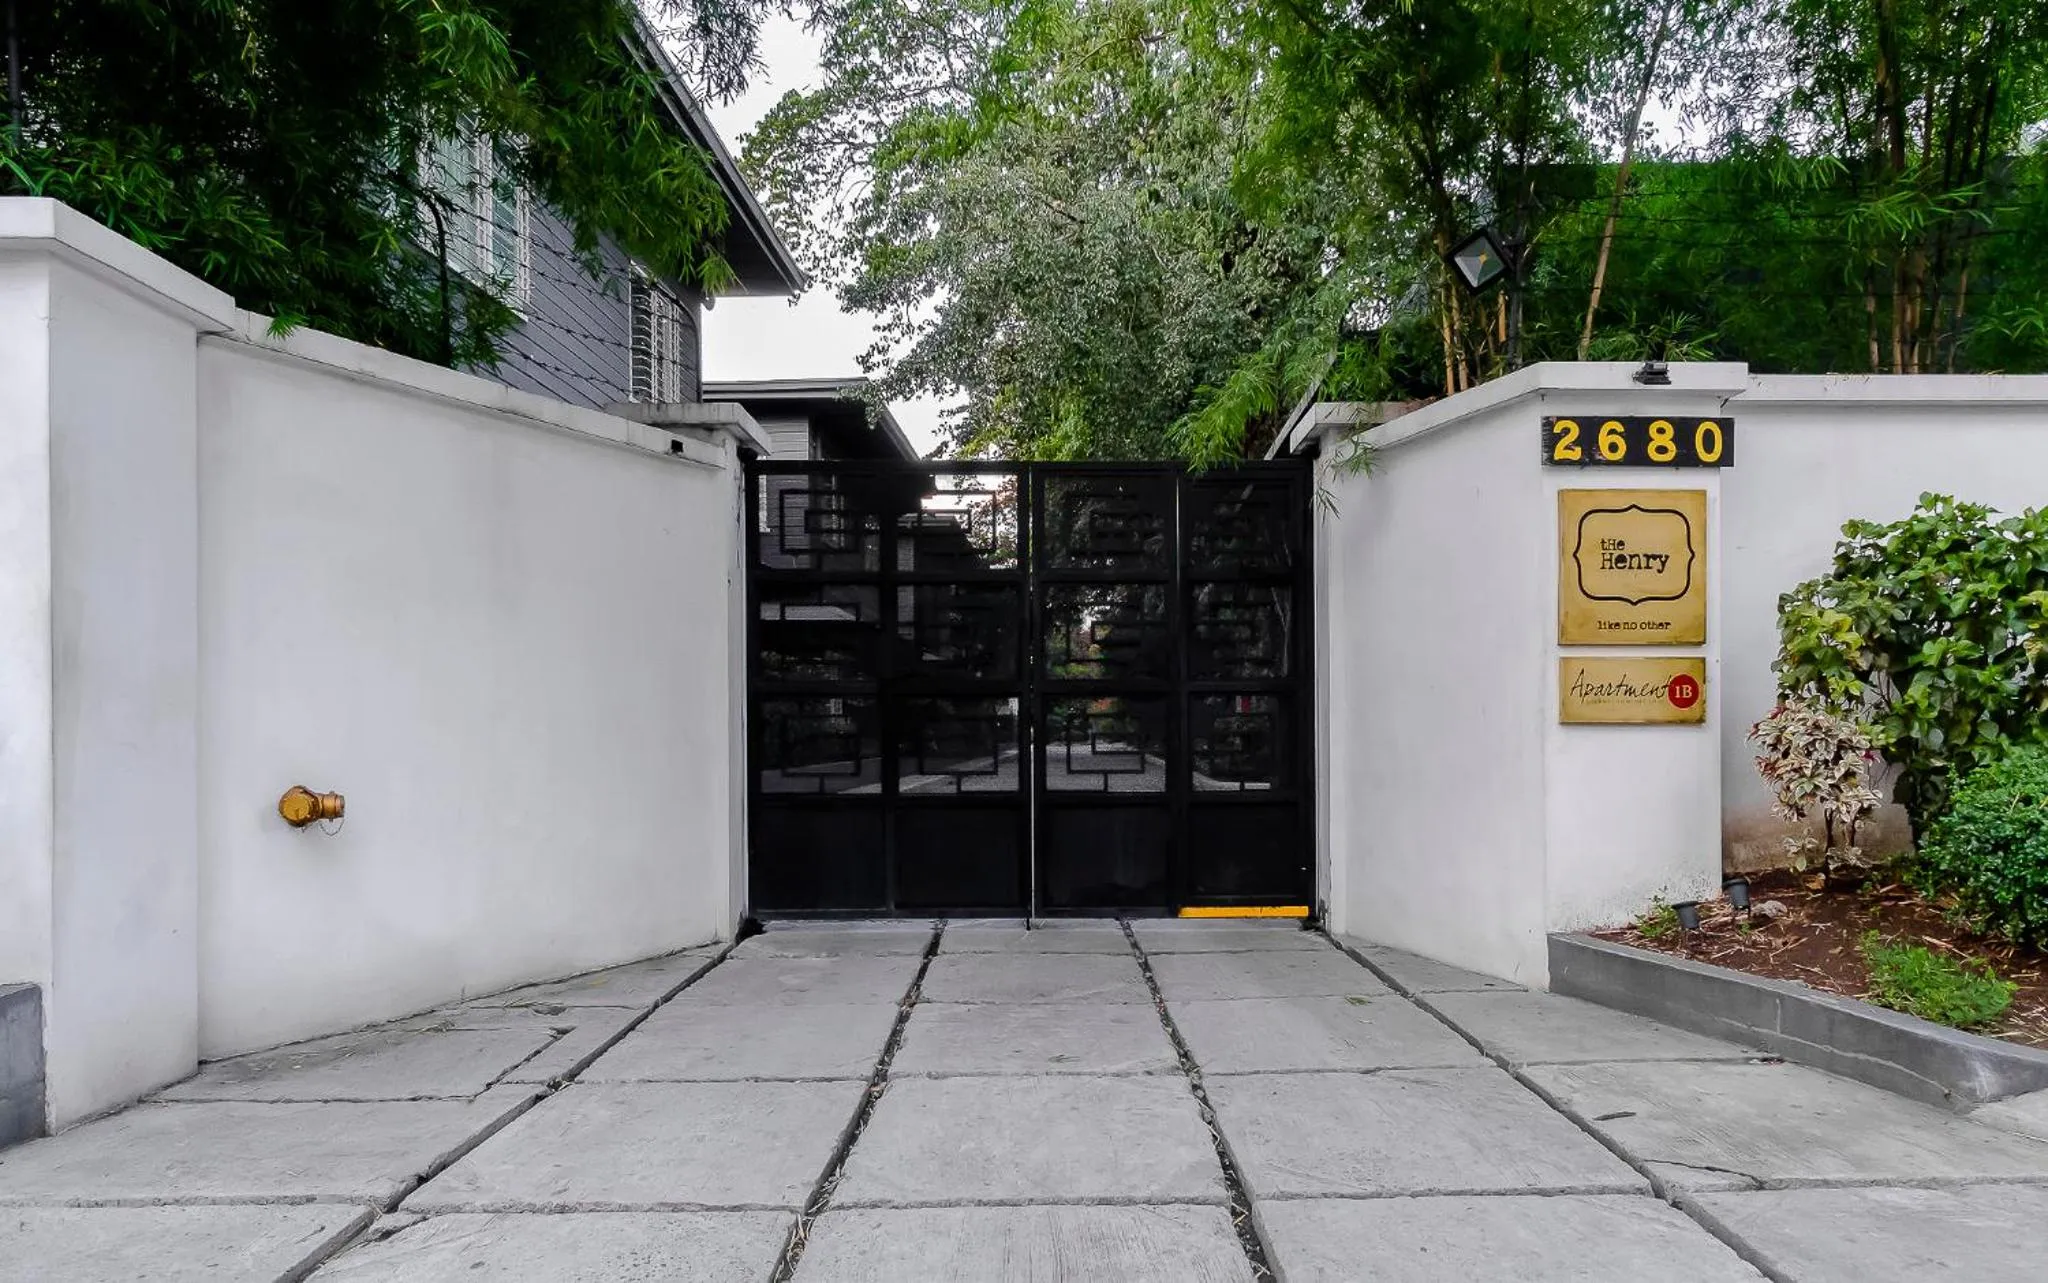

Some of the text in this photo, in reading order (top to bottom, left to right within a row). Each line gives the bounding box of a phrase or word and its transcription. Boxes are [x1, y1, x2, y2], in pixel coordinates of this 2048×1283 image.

[1552, 420, 1723, 462] 2680
[1600, 552, 1670, 574] Henry
[1597, 620, 1672, 631] like no other
[1569, 667, 1693, 704] Apartment 1B
